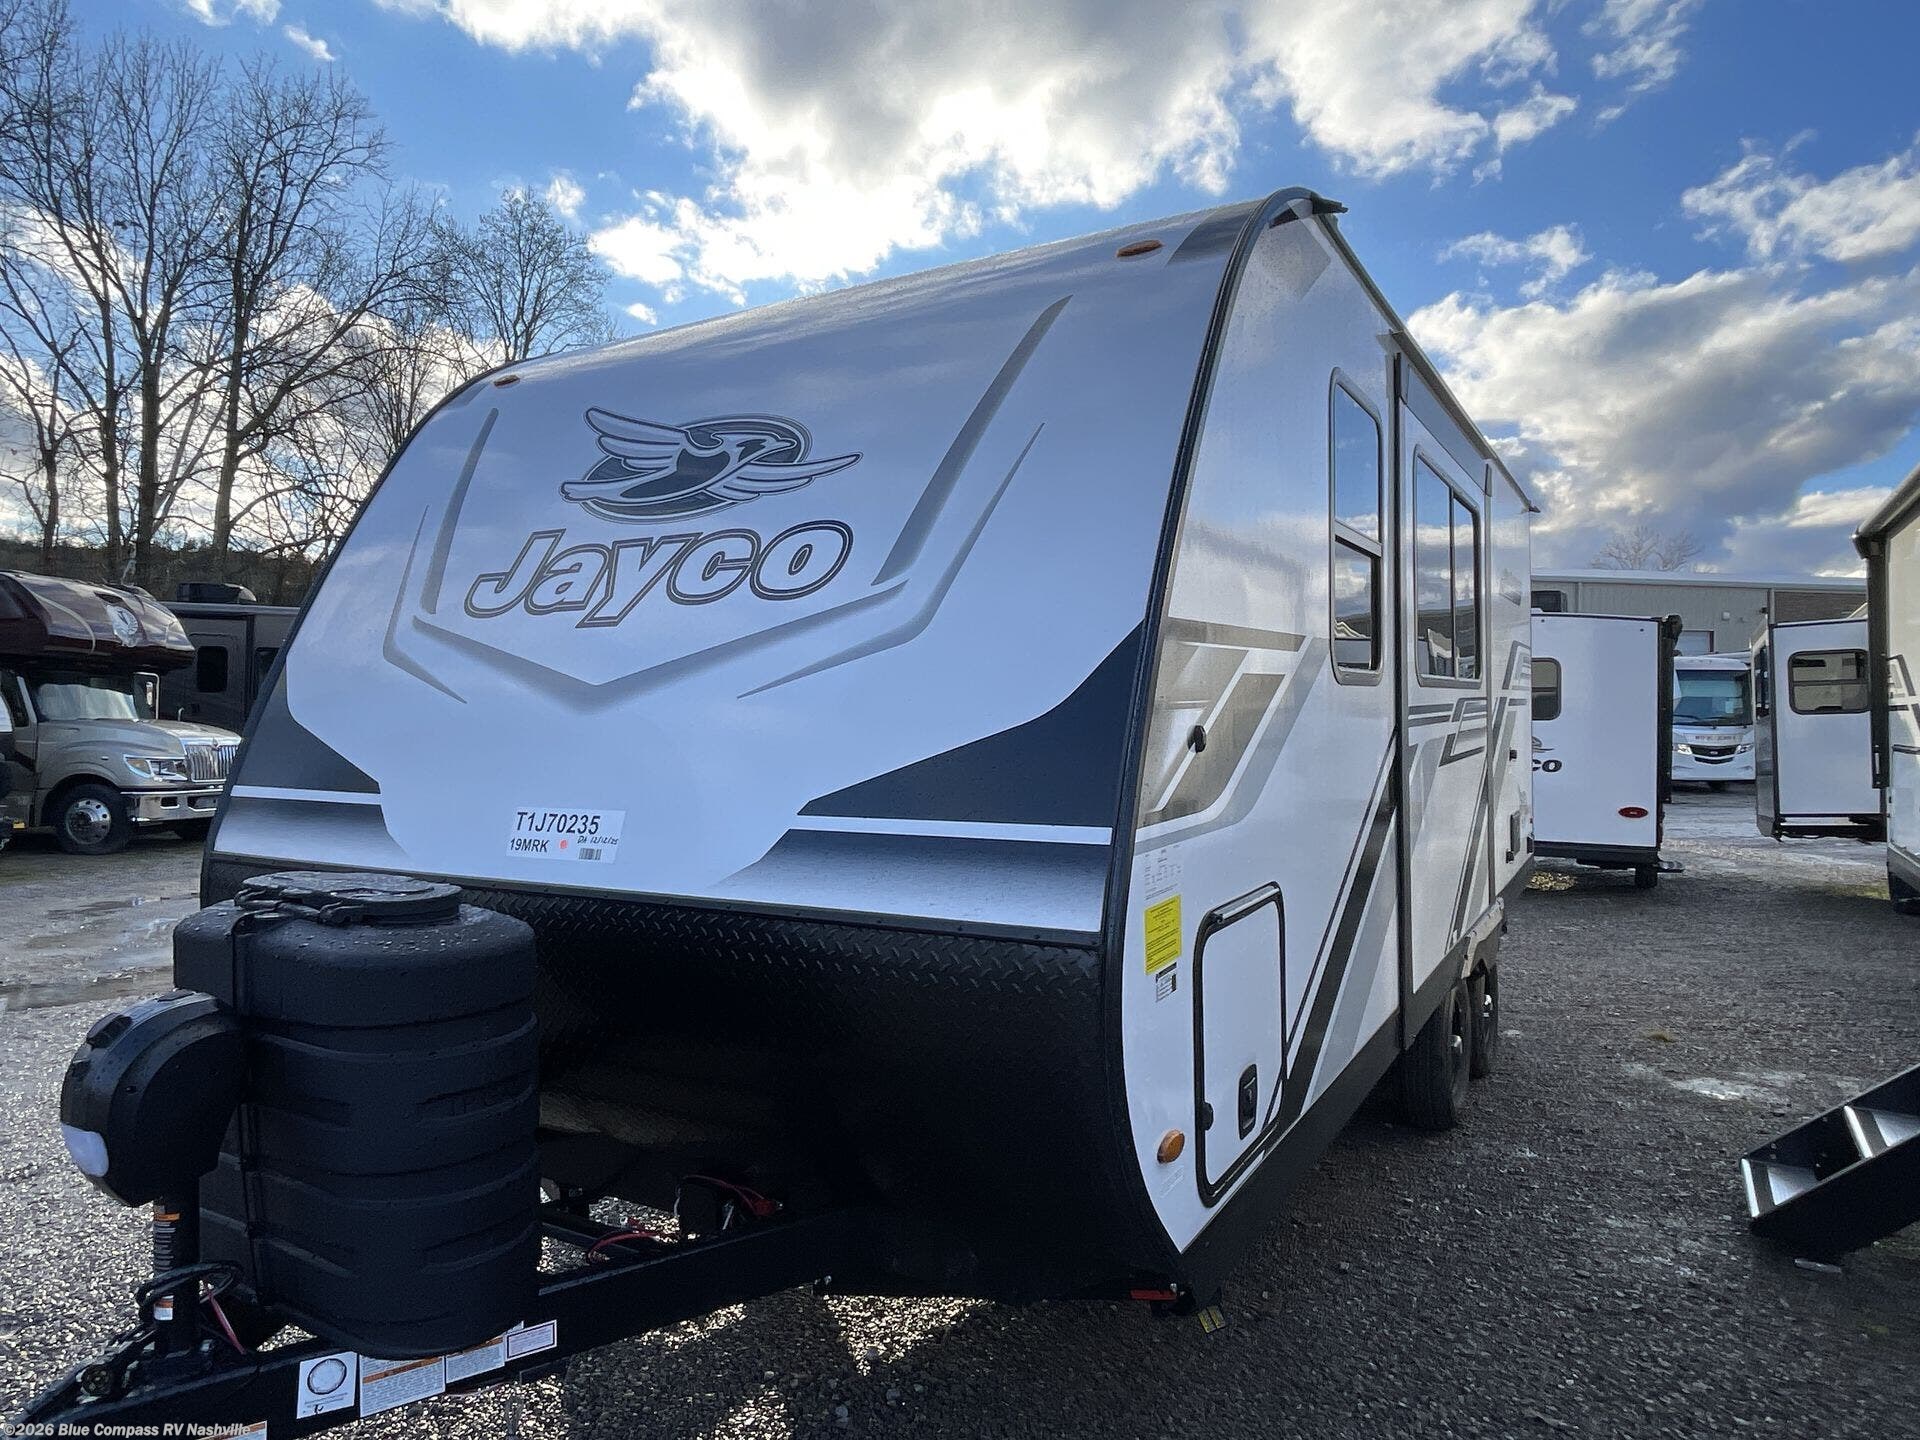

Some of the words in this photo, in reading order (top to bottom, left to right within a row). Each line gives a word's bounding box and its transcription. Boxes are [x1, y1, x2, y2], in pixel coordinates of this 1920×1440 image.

[464, 520, 853, 628] Jayco
[517, 811, 601, 835] T1J70235
[510, 838, 550, 853] 19MRK
